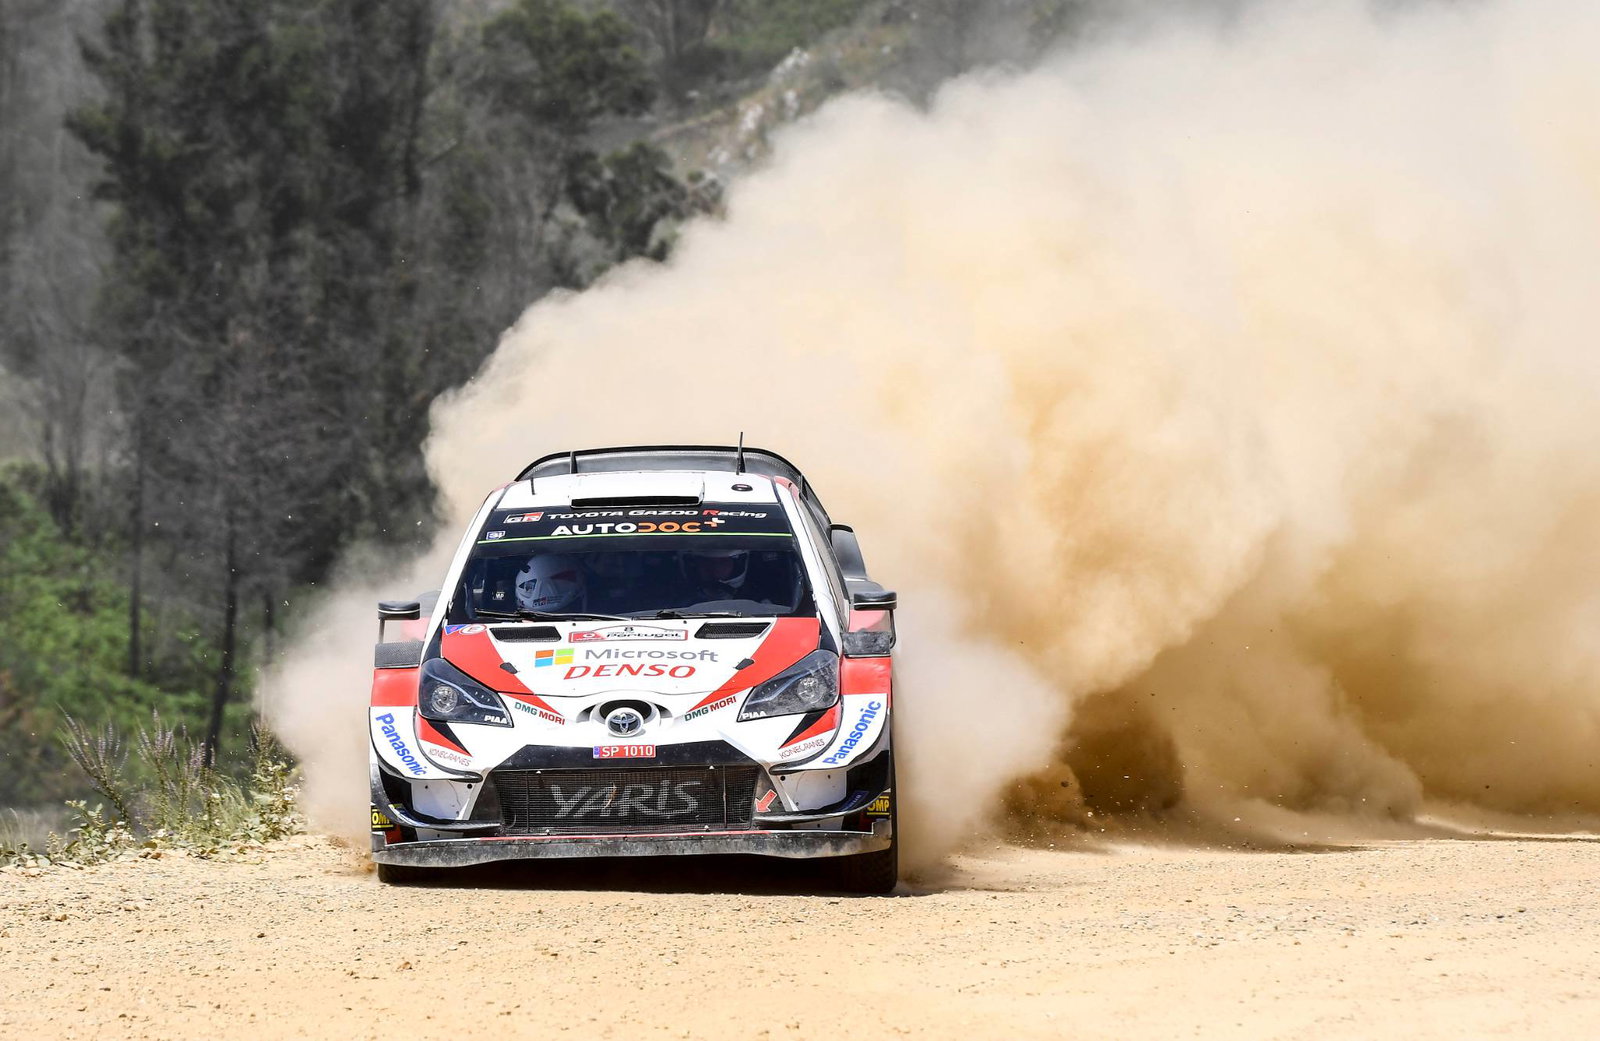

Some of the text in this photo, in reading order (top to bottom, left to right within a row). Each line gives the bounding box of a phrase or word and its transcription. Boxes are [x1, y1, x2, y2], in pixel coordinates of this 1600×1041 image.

[547, 511, 624, 520] TOYOTA
[702, 509, 768, 519] Racing
[585, 648, 719, 662] Microsoft
[563, 663, 697, 680] DENSO
[514, 701, 567, 726] DMG MORI
[684, 695, 738, 722] DMG MORI
[741, 710, 768, 720] PIAA
[484, 714, 508, 725] PIAA
[822, 700, 882, 765] Panasonic
[375, 713, 427, 777] Panasonic
[601, 745, 654, 758] SP 1010
[779, 738, 826, 760] KONECRANES
[551, 780, 701, 817] YARIS
